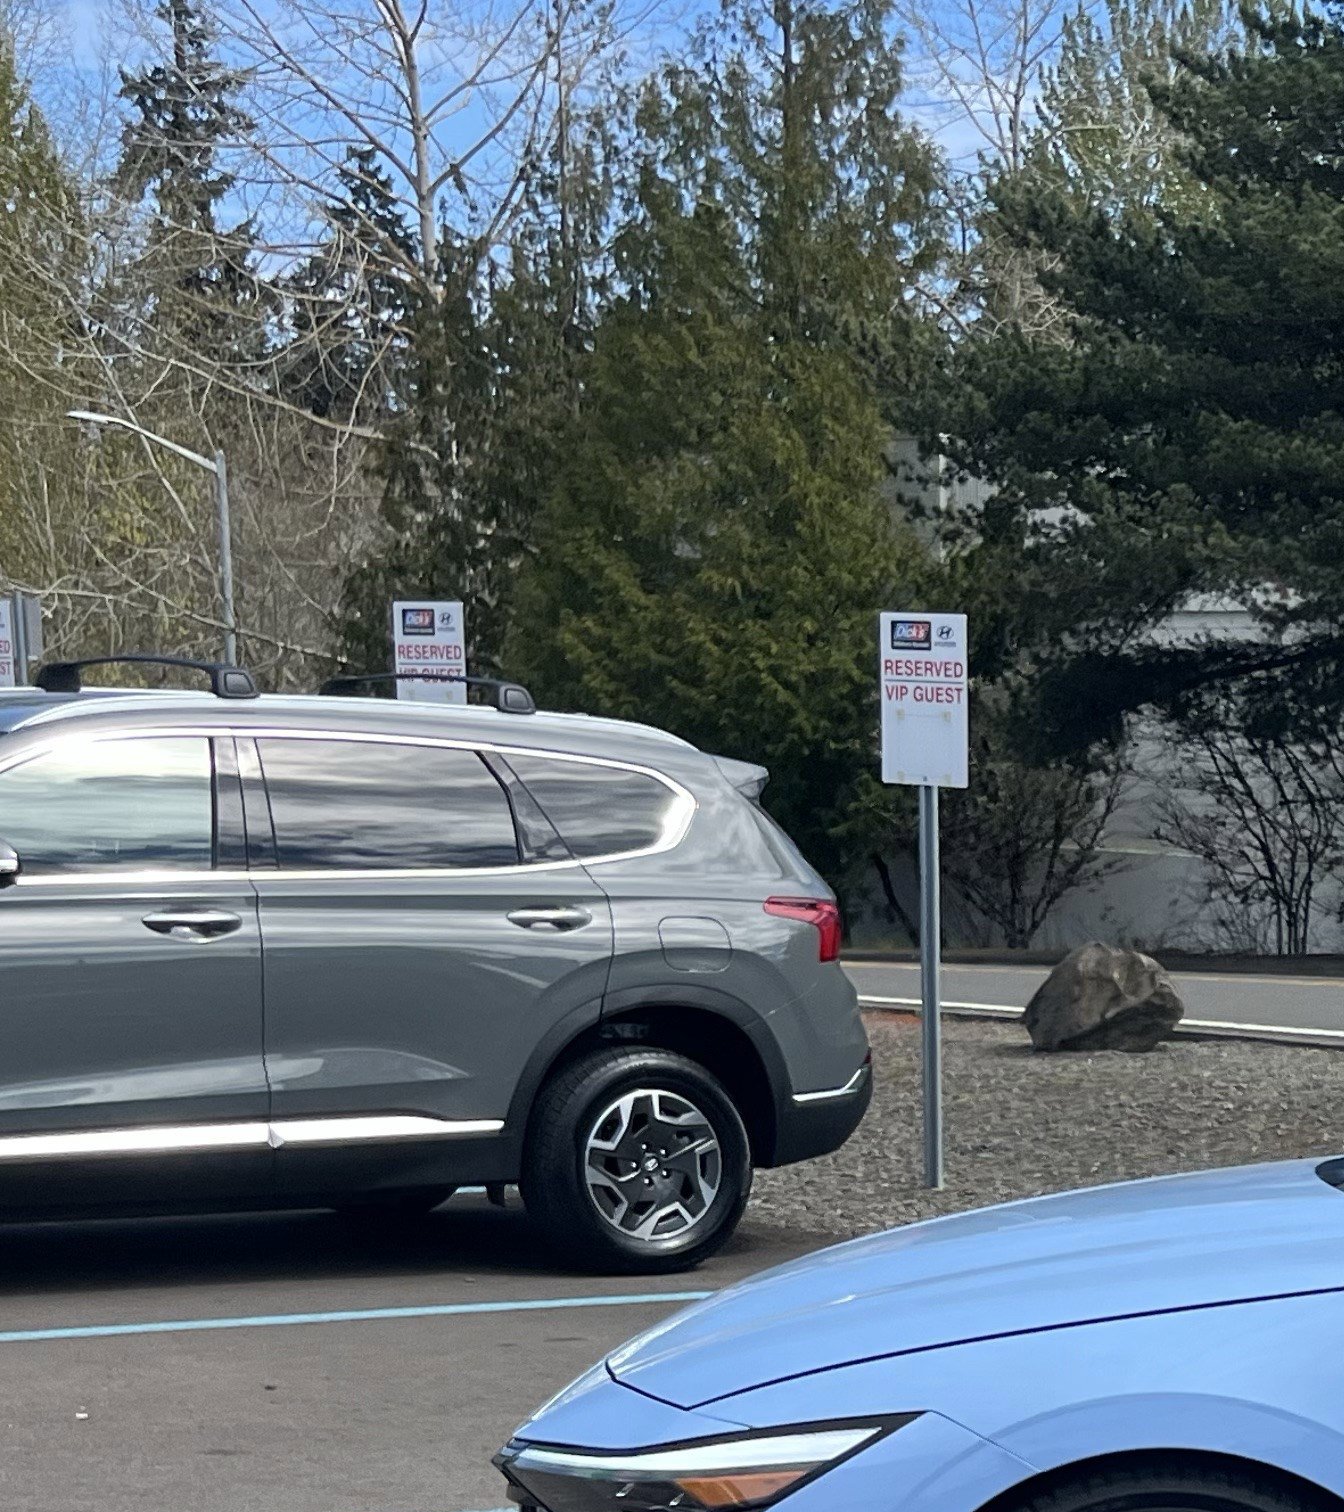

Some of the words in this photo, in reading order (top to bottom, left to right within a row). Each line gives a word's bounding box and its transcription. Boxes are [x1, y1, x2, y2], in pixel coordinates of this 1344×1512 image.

[397, 644, 462, 660] RESERVED
[884, 659, 964, 678] RESERVED
[885, 685, 908, 701] VIP
[913, 686, 963, 704] GUEST
